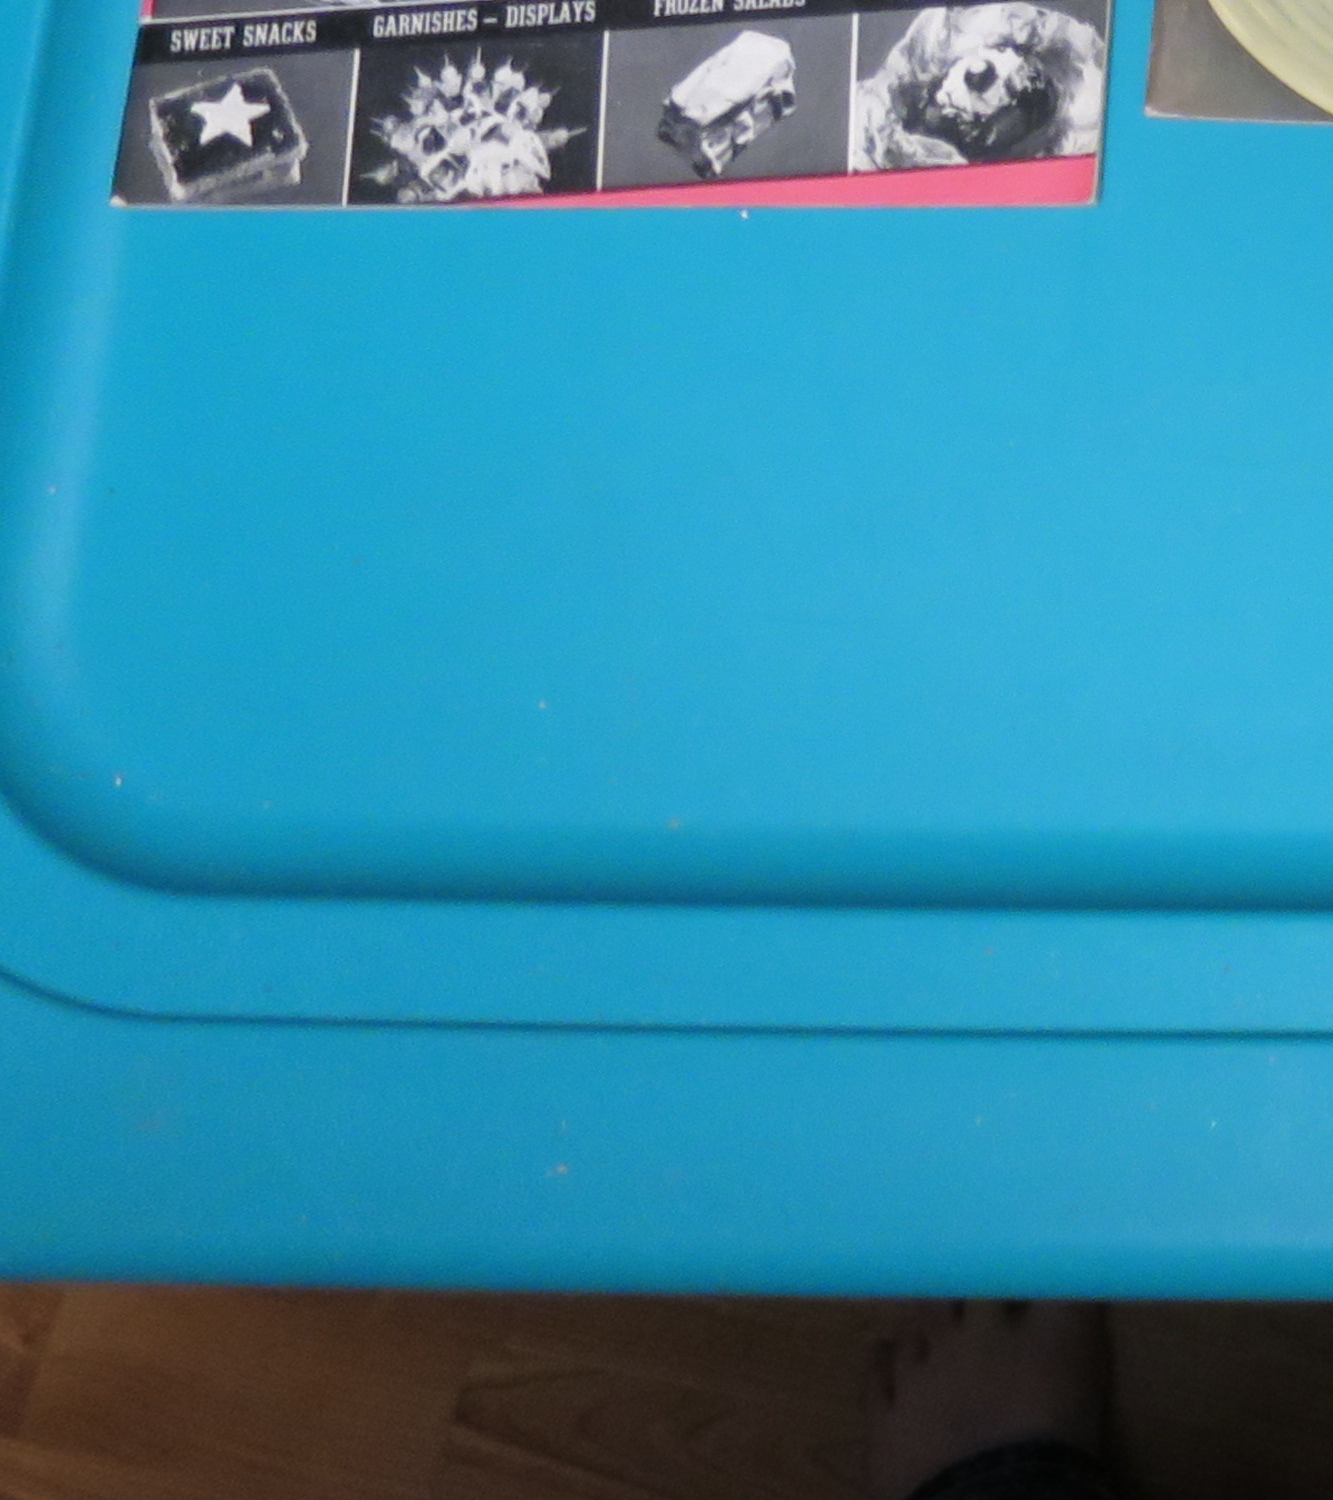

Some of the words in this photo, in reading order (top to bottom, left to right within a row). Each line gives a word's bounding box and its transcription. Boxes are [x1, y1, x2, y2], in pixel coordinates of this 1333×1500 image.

[169, 27, 236, 53] SWEET
[242, 19, 318, 47] SNACKS
[372, 5, 479, 39] GARNISHES
[504, 0, 597, 29] DISPLAYS
